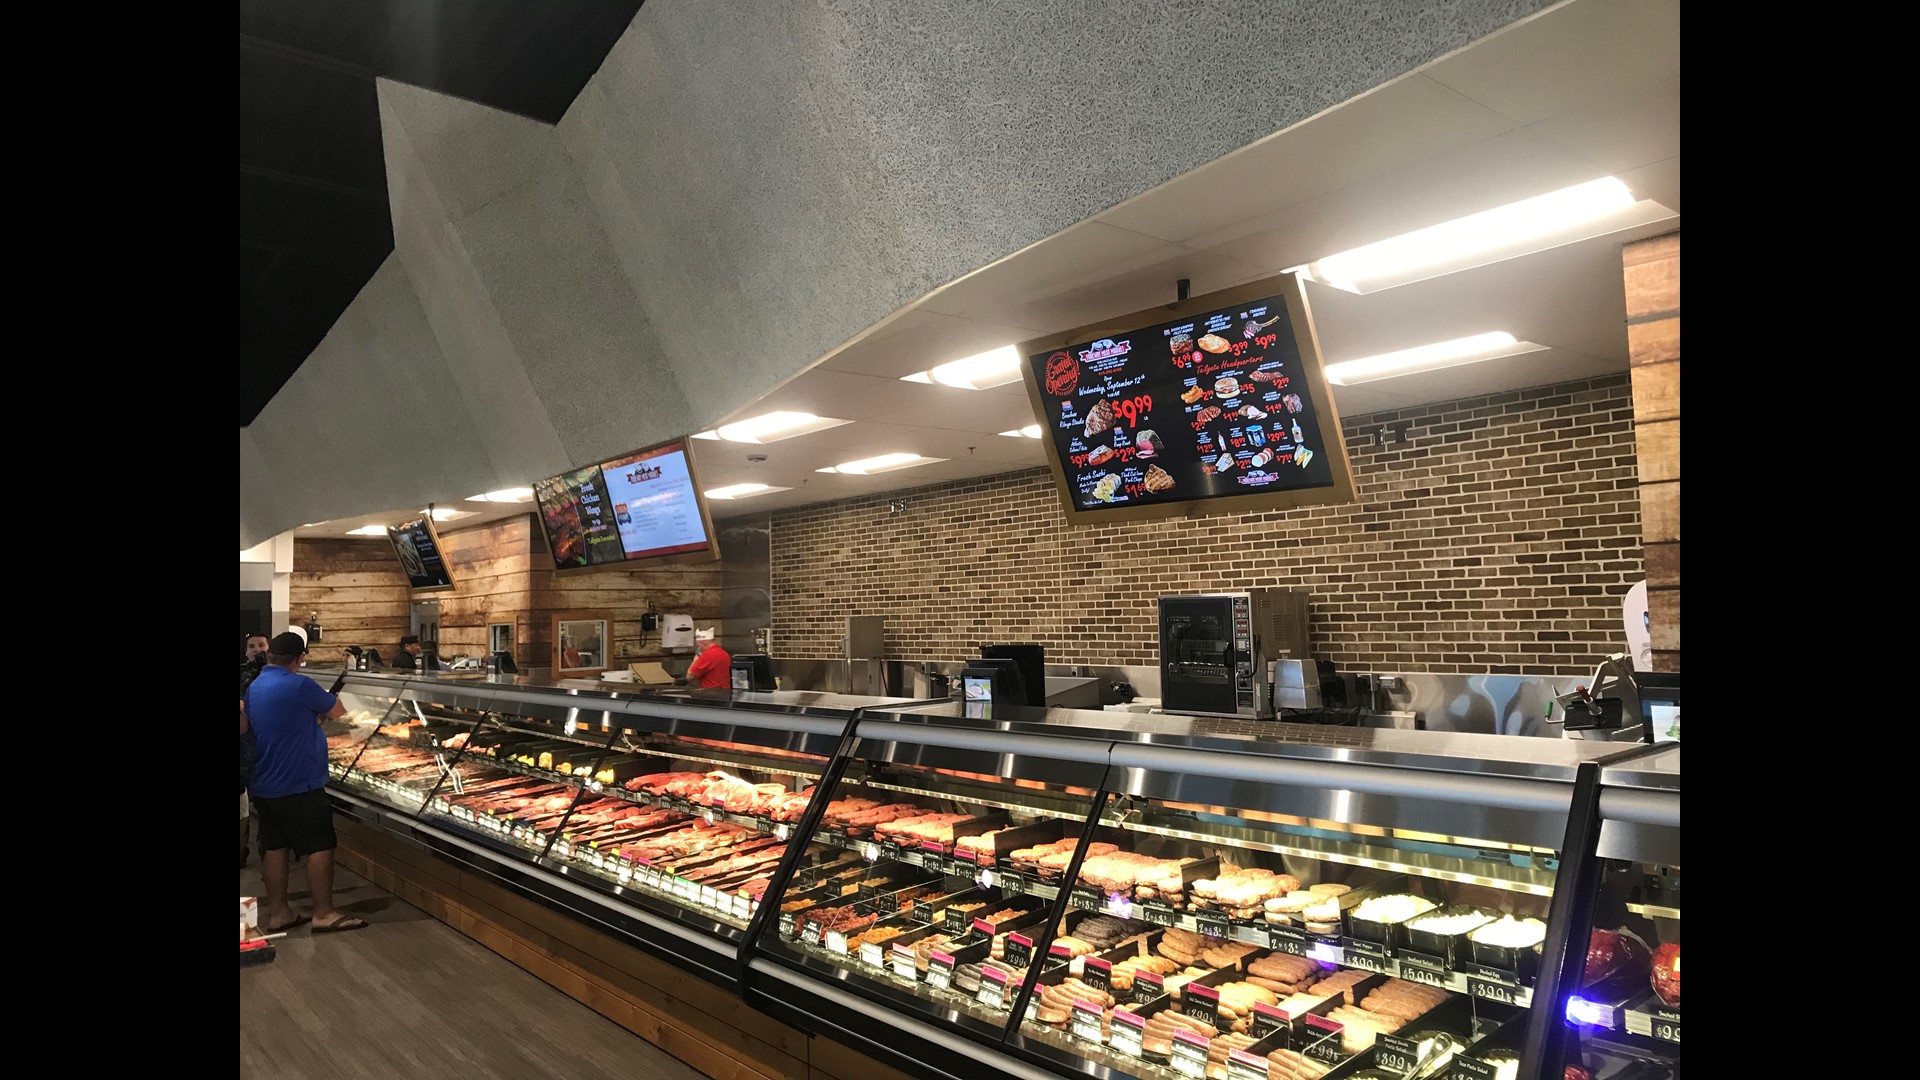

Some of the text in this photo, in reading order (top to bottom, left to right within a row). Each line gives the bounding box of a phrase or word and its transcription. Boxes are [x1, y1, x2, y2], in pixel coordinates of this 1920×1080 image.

[1197, 364, 1220, 375] Tailgate
[1221, 356, 1263, 370] Headquarters
[1107, 380, 1133, 390] September
[580, 493, 600, 504] Chicken
[1121, 1011, 1144, 1022] ADVERTISED
[1182, 1030, 1208, 1044] ADVERTISED
